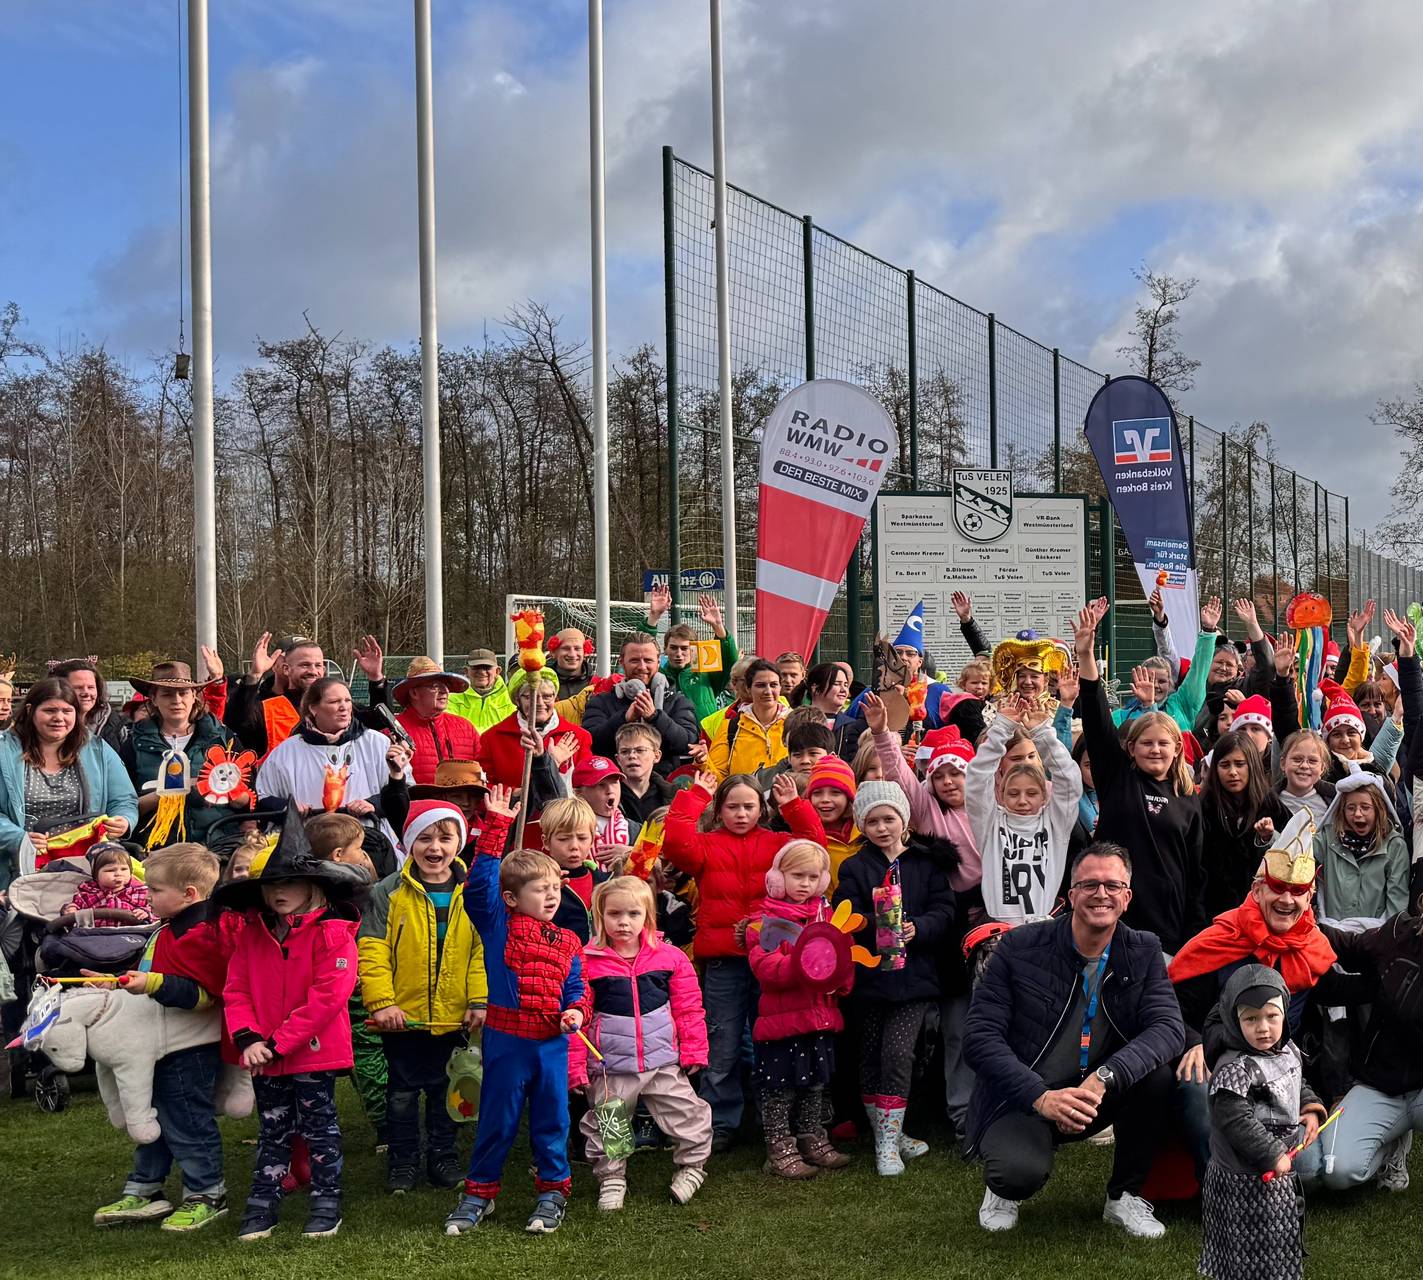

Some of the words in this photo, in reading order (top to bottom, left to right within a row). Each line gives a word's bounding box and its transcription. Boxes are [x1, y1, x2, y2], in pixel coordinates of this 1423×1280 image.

[787, 427, 843, 457] WMW
[791, 410, 889, 454] RADIO
[779, 448, 797, 459] 88.4
[804, 456, 822, 467] 93.0
[828, 464, 846, 476] 97.6
[780, 465, 803, 479] DER
[804, 472, 840, 490] BESTE
[840, 484, 864, 500] MIX.
[956, 472, 974, 481] TuS
[976, 472, 1010, 482] VELEN
[985, 486, 1008, 496] 1925
[651, 574, 697, 586] Allnz
